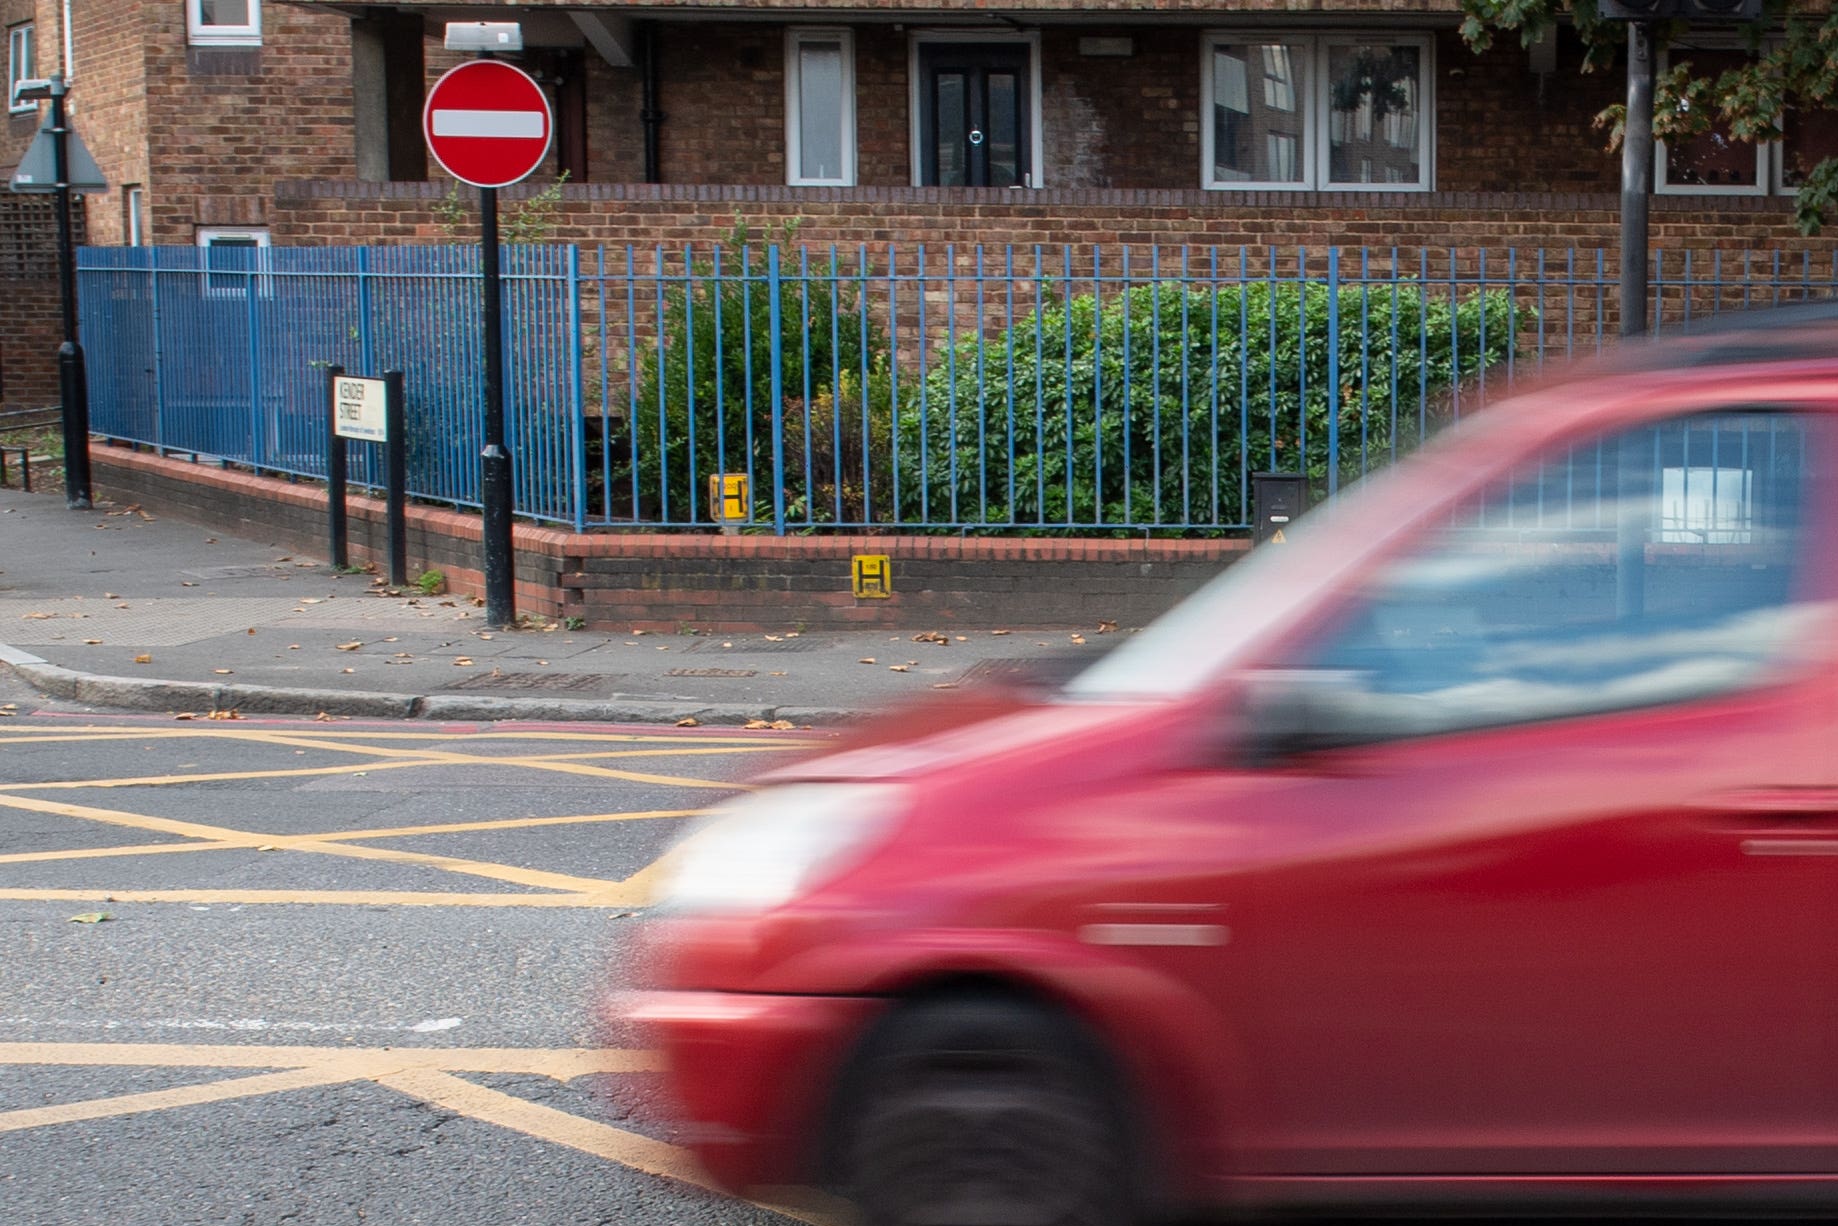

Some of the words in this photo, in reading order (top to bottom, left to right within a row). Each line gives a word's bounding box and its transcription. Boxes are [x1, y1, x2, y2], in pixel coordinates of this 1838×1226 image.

[340, 402, 361, 420] STREET
[717, 480, 743, 513] H
[858, 560, 884, 593] H
